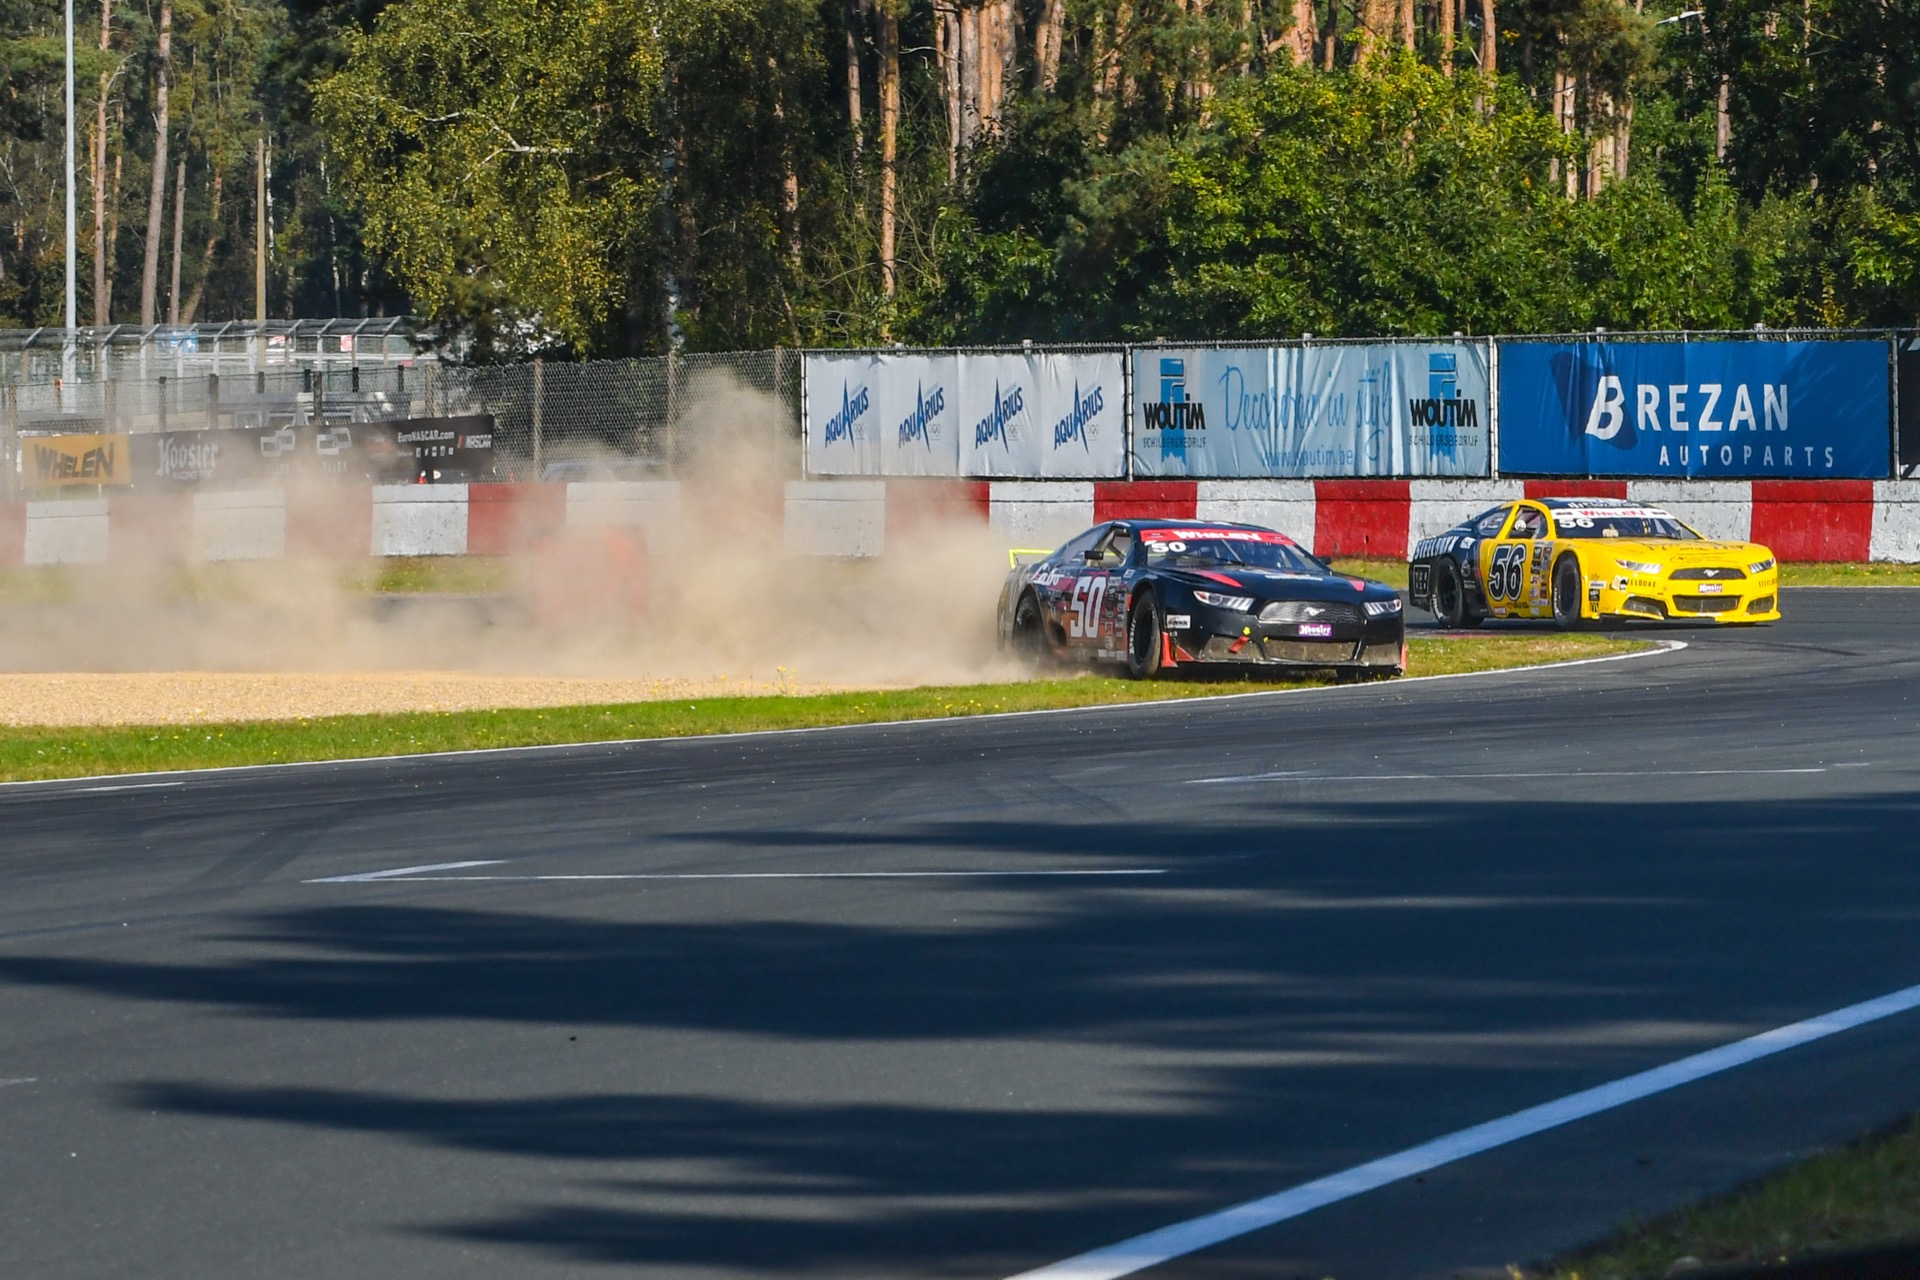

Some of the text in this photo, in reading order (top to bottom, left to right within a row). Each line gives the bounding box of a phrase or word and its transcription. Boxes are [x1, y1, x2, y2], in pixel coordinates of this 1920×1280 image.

[1328, 371, 1348, 427] in
[1356, 360, 1391, 461] stijl
[1585, 375, 1788, 440] BREZAN
[397, 430, 455, 443] EuroNASCAR.com
[1143, 437, 1206, 449] SCHILDERSBEDRIJF
[1409, 434, 1478, 446] SCHILDERSBEDRIJF
[34, 443, 114, 479] WHELEN
[156, 435, 218, 477] Hoosier
[1660, 445, 1833, 468] AUTOPARTS
[1559, 517, 1595, 529] 56
[1151, 541, 1187, 553] 50
[1488, 544, 1526, 602] 56
[1070, 576, 1106, 638] 50
